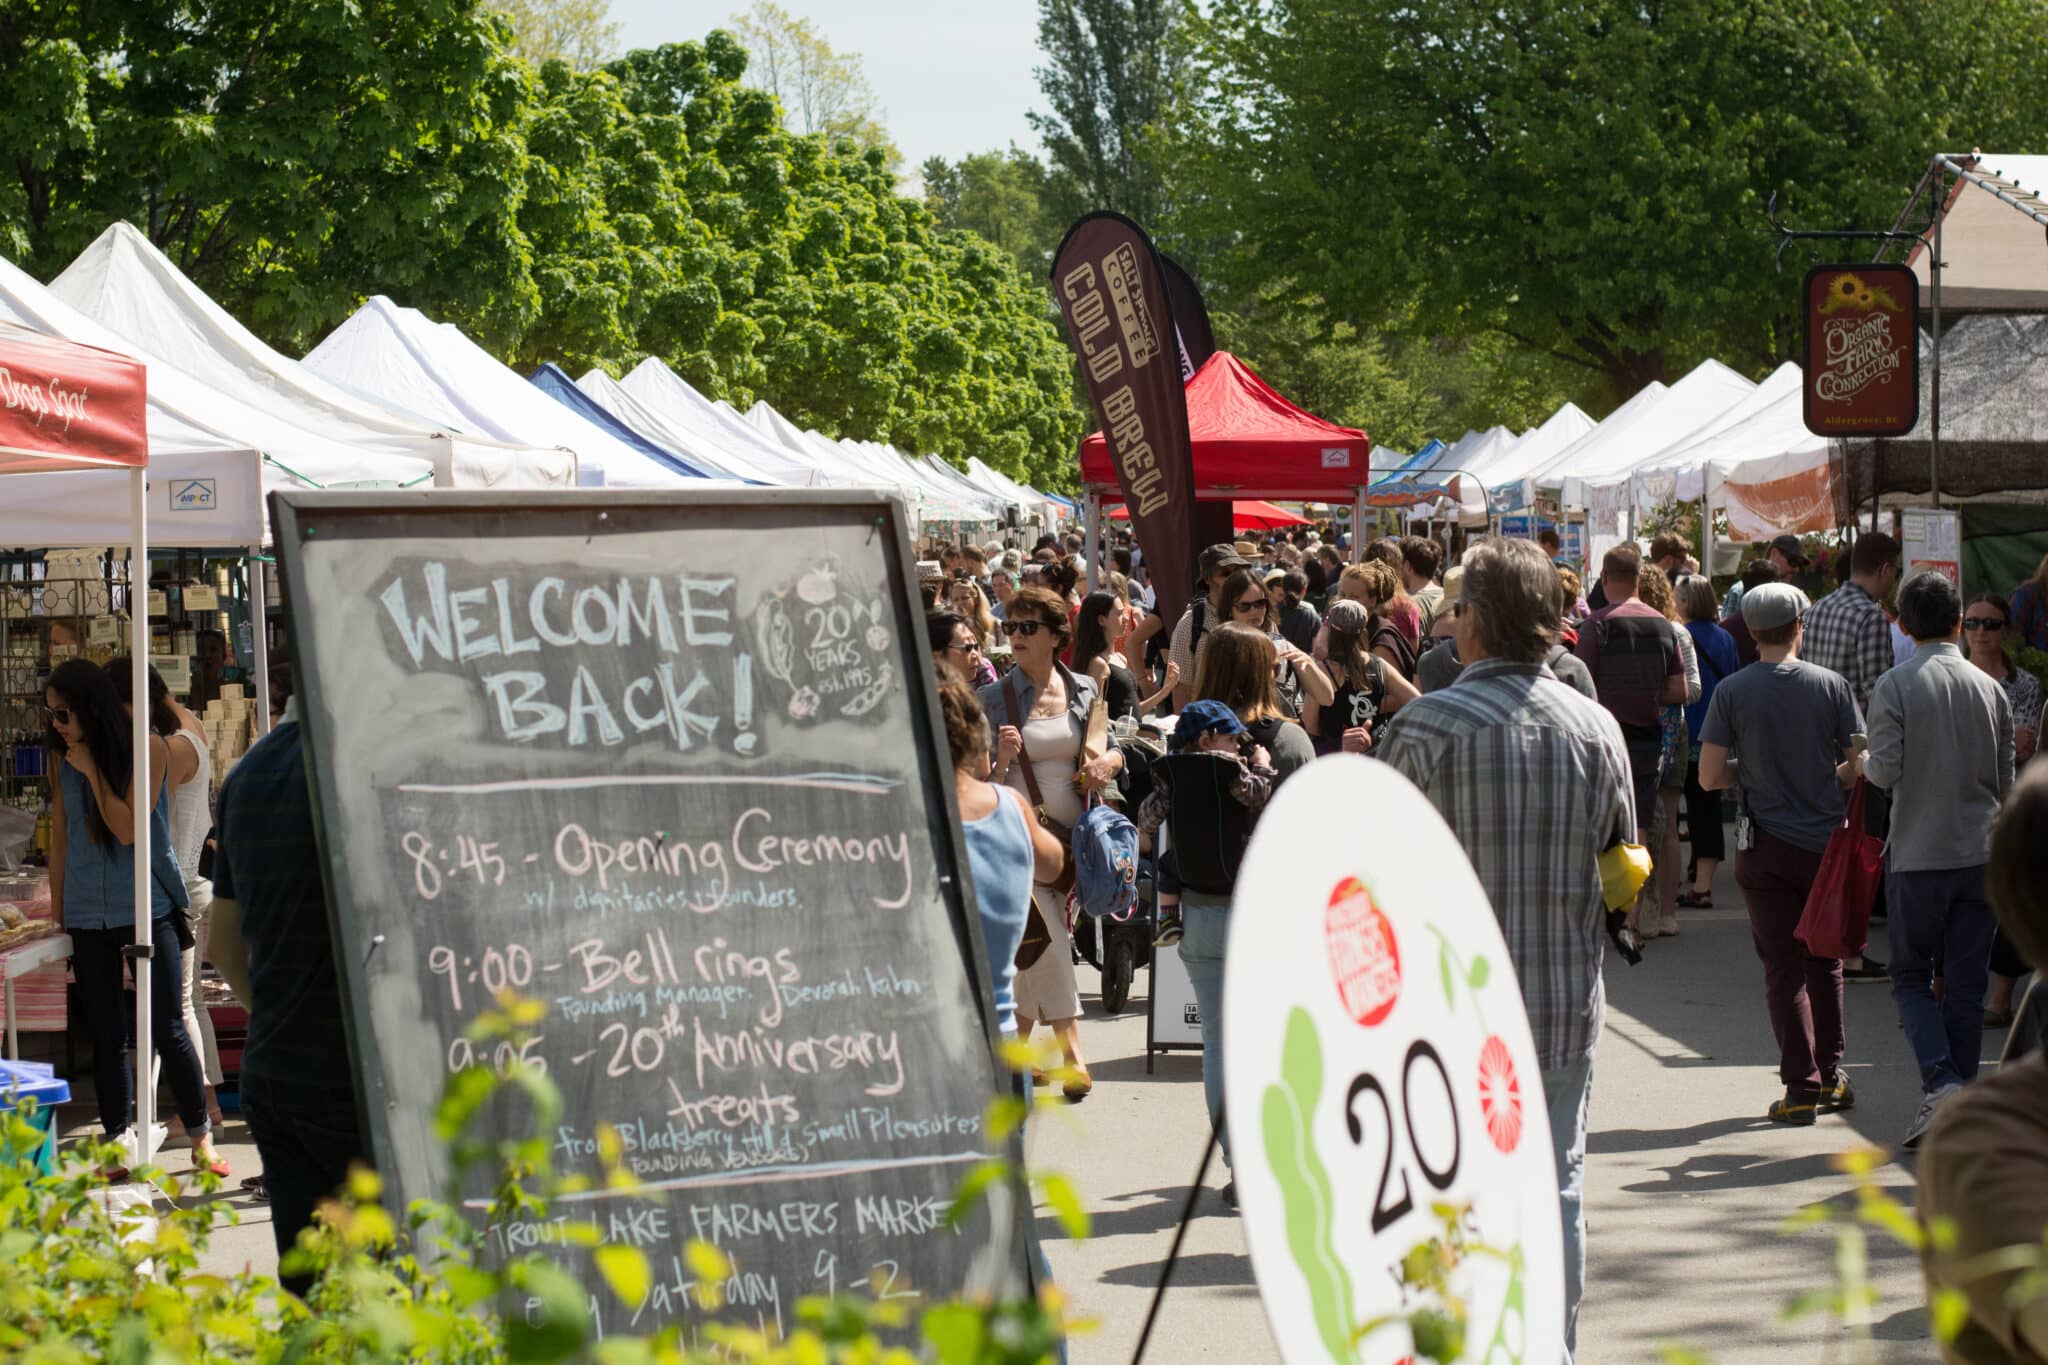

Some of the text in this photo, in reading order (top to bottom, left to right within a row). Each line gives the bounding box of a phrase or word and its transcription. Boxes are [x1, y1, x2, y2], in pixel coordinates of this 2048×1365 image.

[1108, 262, 1147, 360] COFFEE
[1826, 313, 1890, 355] ORGANIC
[1063, 261, 1168, 518] COLD BREW
[1816, 350, 1900, 401] CONNECTION
[1826, 334, 1892, 376] FARM
[0, 367, 48, 427] Drop
[380, 562, 735, 666] WELCOME
[805, 605, 851, 648] 20
[804, 639, 861, 671] YEARS
[485, 653, 758, 757] BACK!
[401, 831, 506, 900] 8:45
[555, 823, 730, 912] Opening
[731, 808, 912, 908] Ceremony
[428, 943, 533, 1011] 9:00
[570, 928, 679, 993] Bell
[694, 937, 799, 1028] rings
[599, 1003, 685, 1078] 20th
[694, 1015, 904, 1096] Anniversary
[554, 1125, 608, 1157] fro
[861, 1106, 980, 1141] Pleasures
[666, 1076, 800, 1130] treats
[1344, 1038, 1461, 1235] 20
[490, 1215, 568, 1259] TROUT
[690, 1199, 838, 1246] FARMERS
[855, 1194, 961, 1237] MARKE
[631, 1250, 784, 1342] aturday
